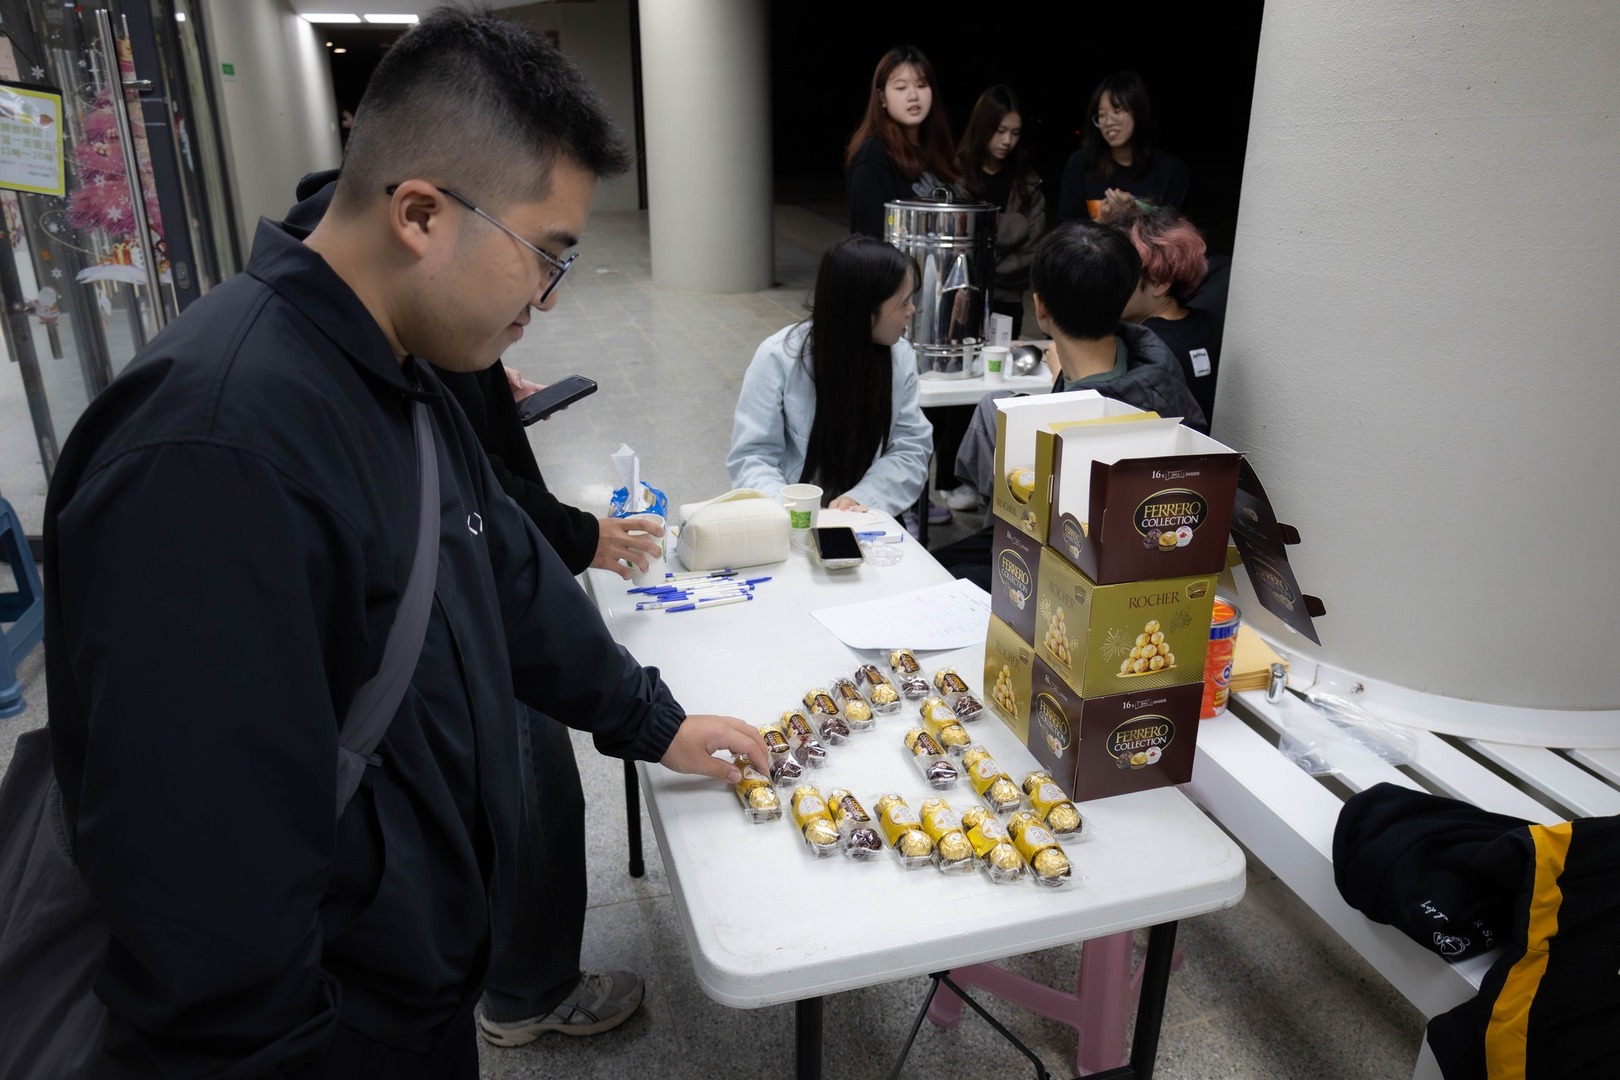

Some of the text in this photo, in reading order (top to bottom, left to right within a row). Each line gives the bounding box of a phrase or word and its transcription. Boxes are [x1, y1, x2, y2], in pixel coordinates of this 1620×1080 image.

[1143, 501, 1202, 519] FERRERO
[1141, 514, 1199, 528] COLLECTION
[1002, 556, 1029, 585] FERRERO
[1001, 568, 1028, 595] COLLECTION
[1129, 591, 1181, 609] ROCHER
[1038, 710, 1066, 744] COLLECTION
[1040, 699, 1068, 735] FERRERO
[1114, 736, 1167, 752] COLLECTION
[1115, 724, 1169, 744] FERRERO
